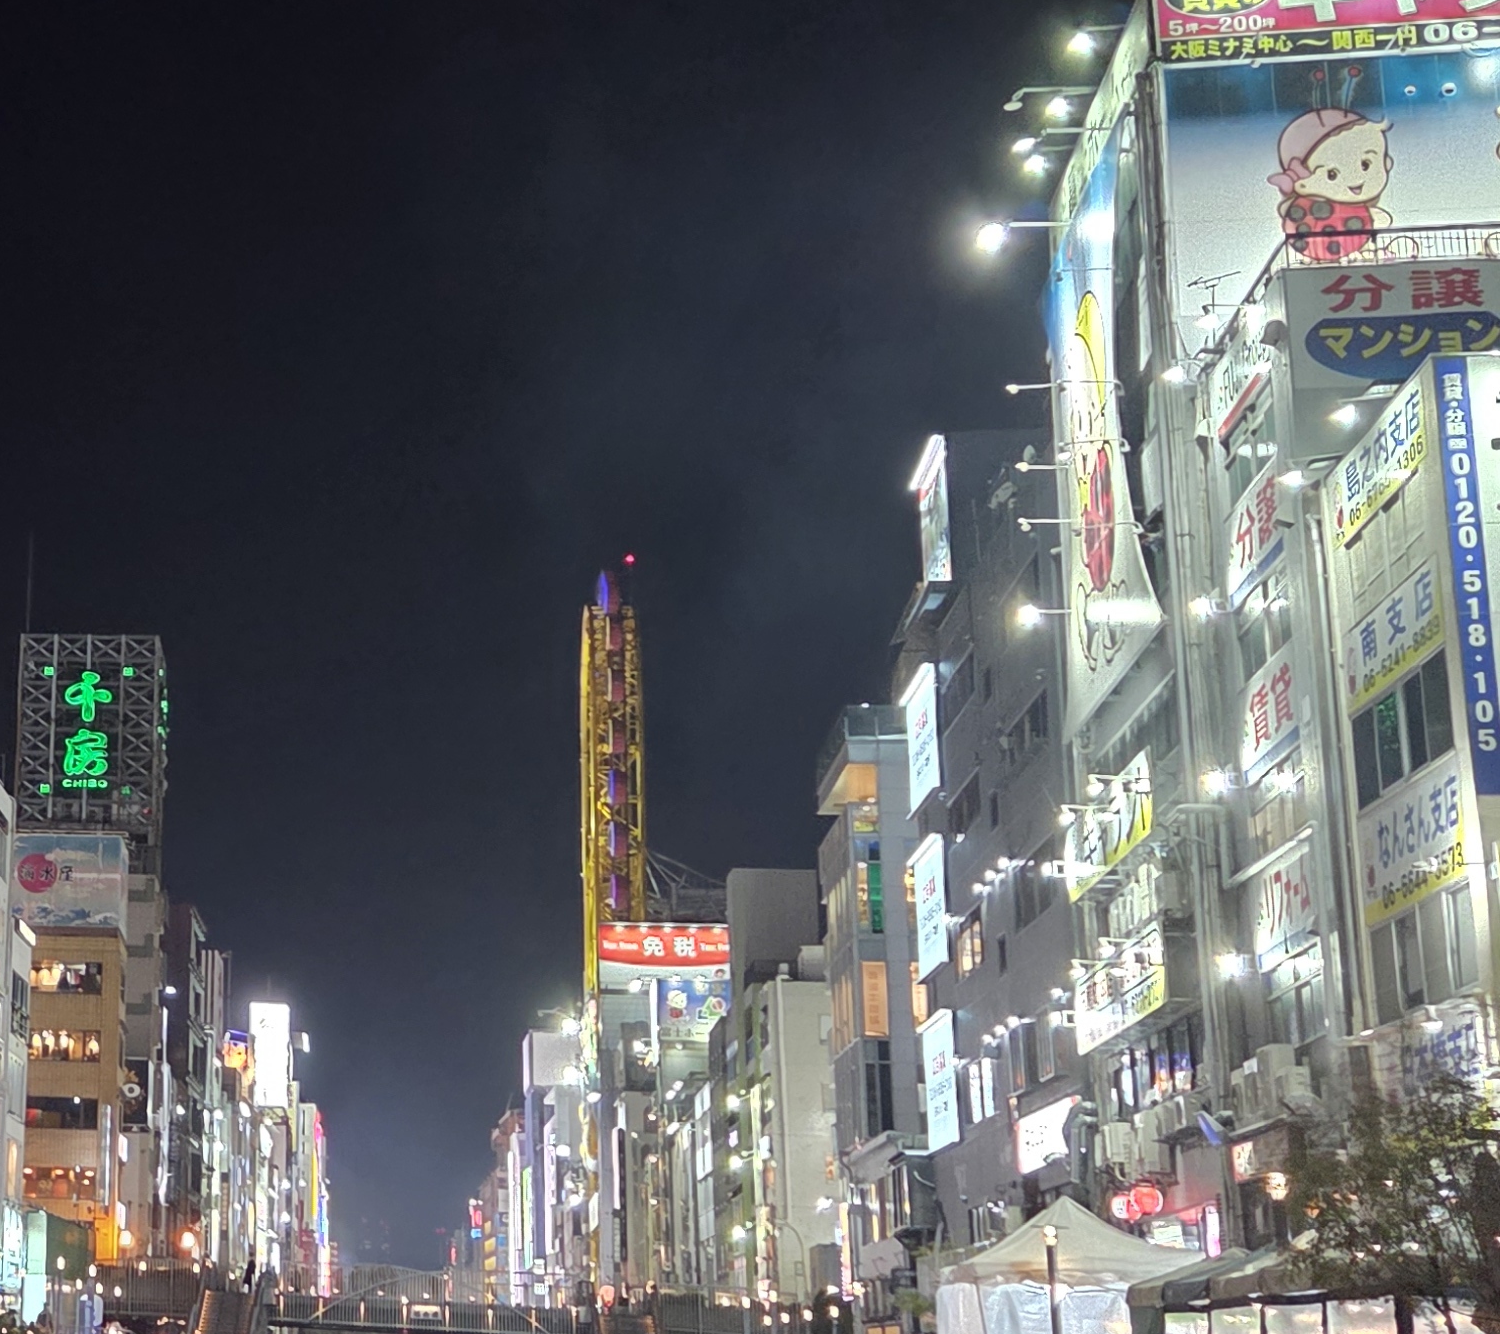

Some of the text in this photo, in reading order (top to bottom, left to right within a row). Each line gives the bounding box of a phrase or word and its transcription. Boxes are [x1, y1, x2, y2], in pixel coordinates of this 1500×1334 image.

[1320, 267, 1486, 313] 分譲
[1318, 318, 1500, 360] マンション
[1345, 388, 1421, 502] 島之内支店
[1235, 473, 1278, 569] 分譲
[1359, 568, 1434, 668] 南支店
[63, 670, 113, 776] 千房
[1250, 662, 1294, 753] 賃貸
[61, 778, 109, 789] CHIBO
[1376, 773, 1459, 870] なんさん支店
[642, 935, 698, 958] 免税
[1263, 869, 1311, 940] リフォーム
